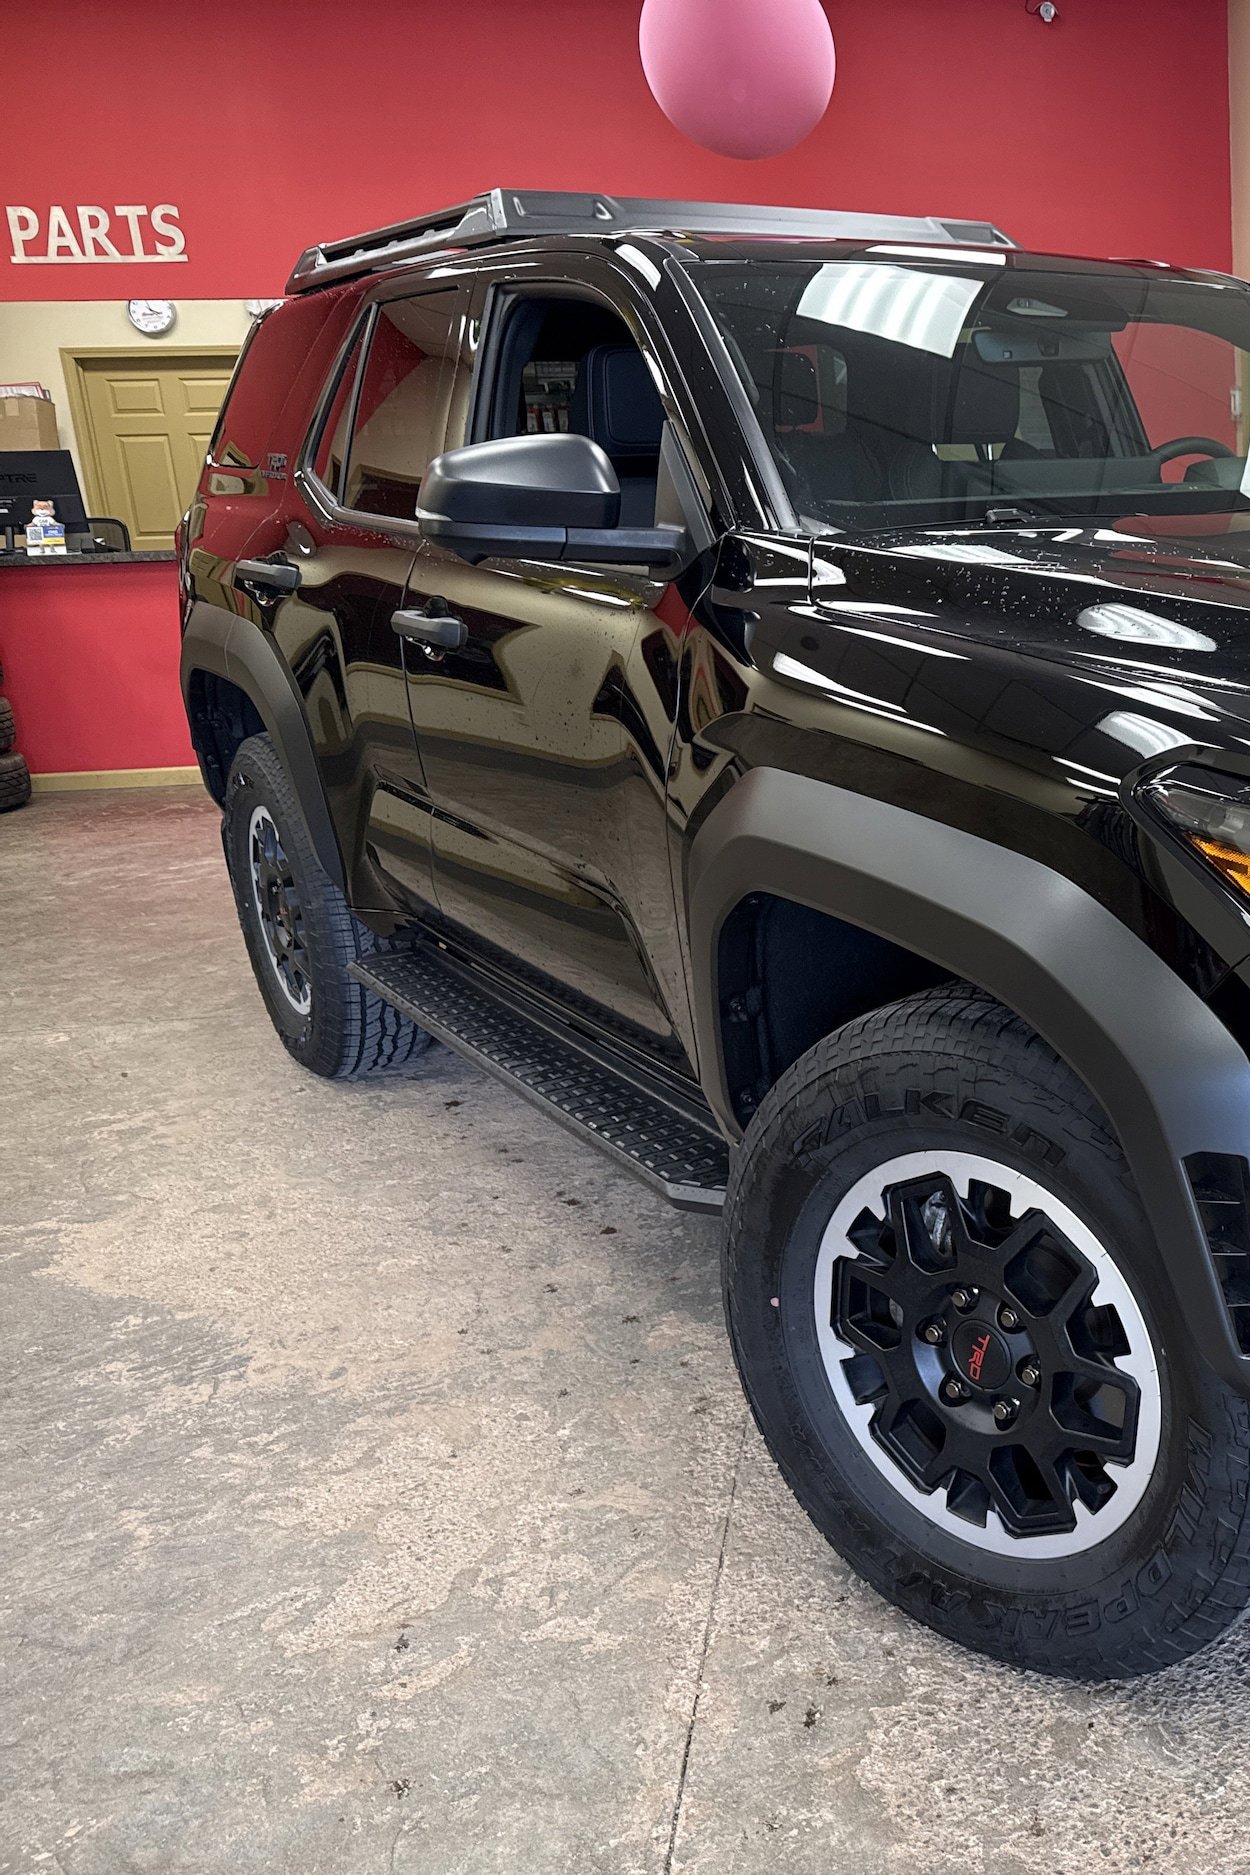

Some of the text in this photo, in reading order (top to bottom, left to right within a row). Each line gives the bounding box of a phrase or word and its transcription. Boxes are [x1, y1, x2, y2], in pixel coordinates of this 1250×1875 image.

[6, 204, 187, 259] PARTS
[793, 1088, 1067, 1168] FALKEN
[968, 1334, 991, 1380] TRD
[983, 1415, 1214, 1641] WILDPEAK
